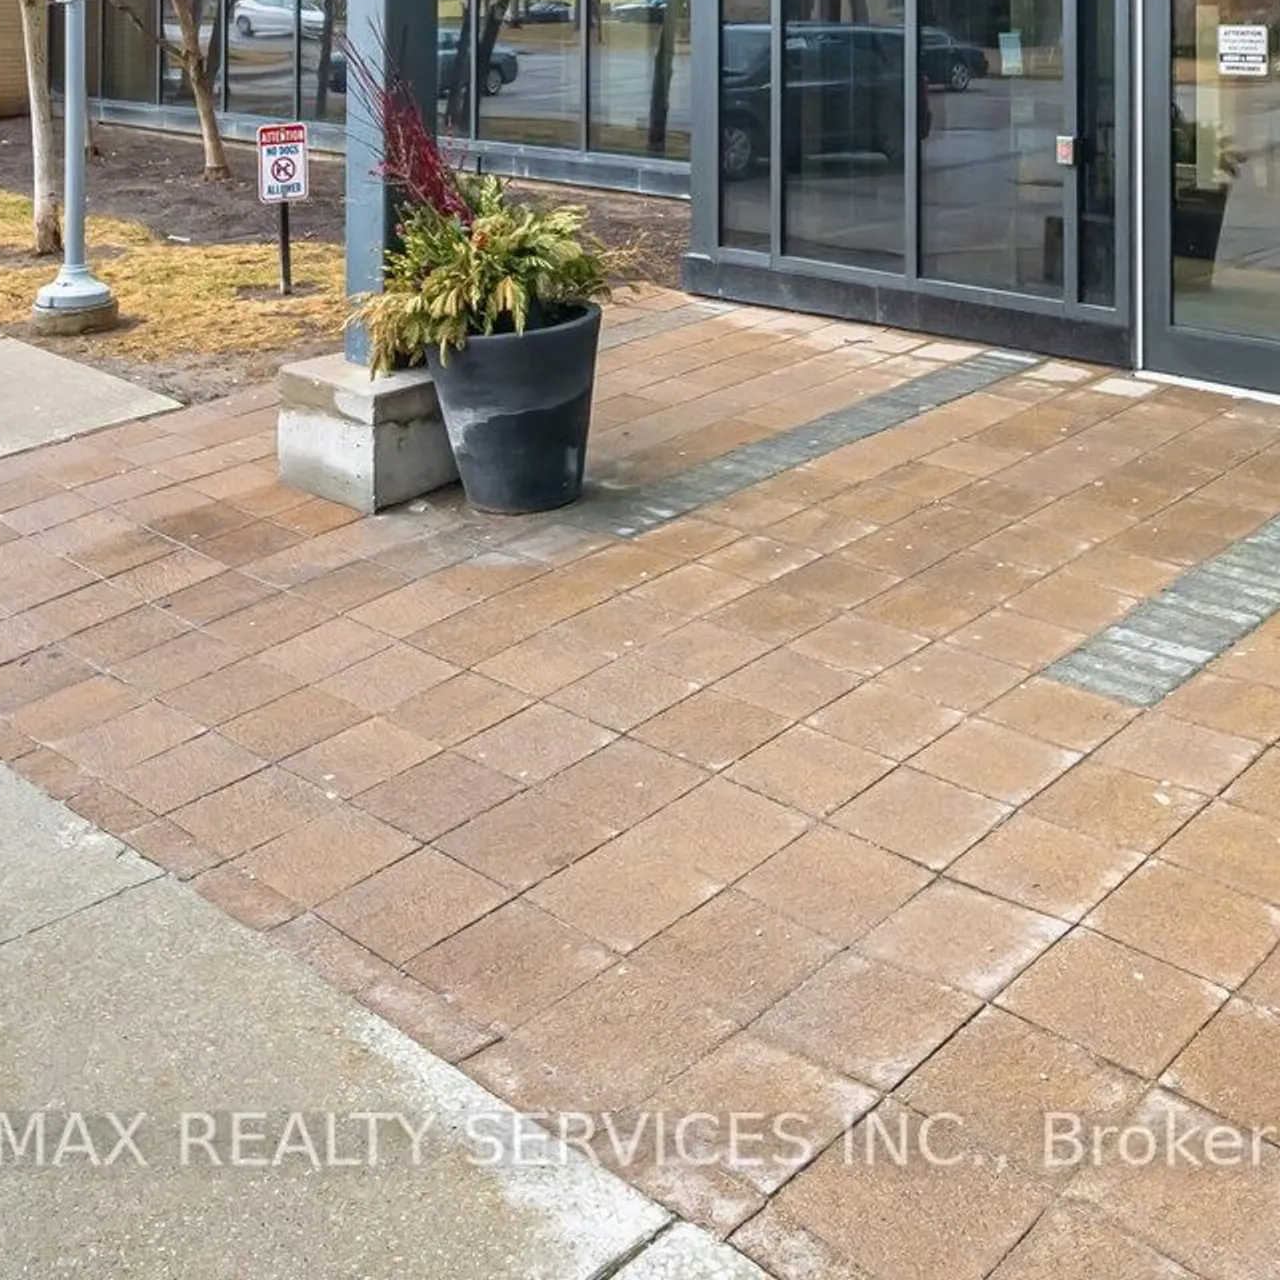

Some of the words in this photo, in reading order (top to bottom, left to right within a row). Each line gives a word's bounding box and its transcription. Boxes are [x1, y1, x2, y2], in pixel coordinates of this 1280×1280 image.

[261, 130, 304, 143] ATTENTION
[266, 146, 277, 156] NO
[279, 145, 299, 155] DOGS
[268, 183, 301, 194] ALLOWED
